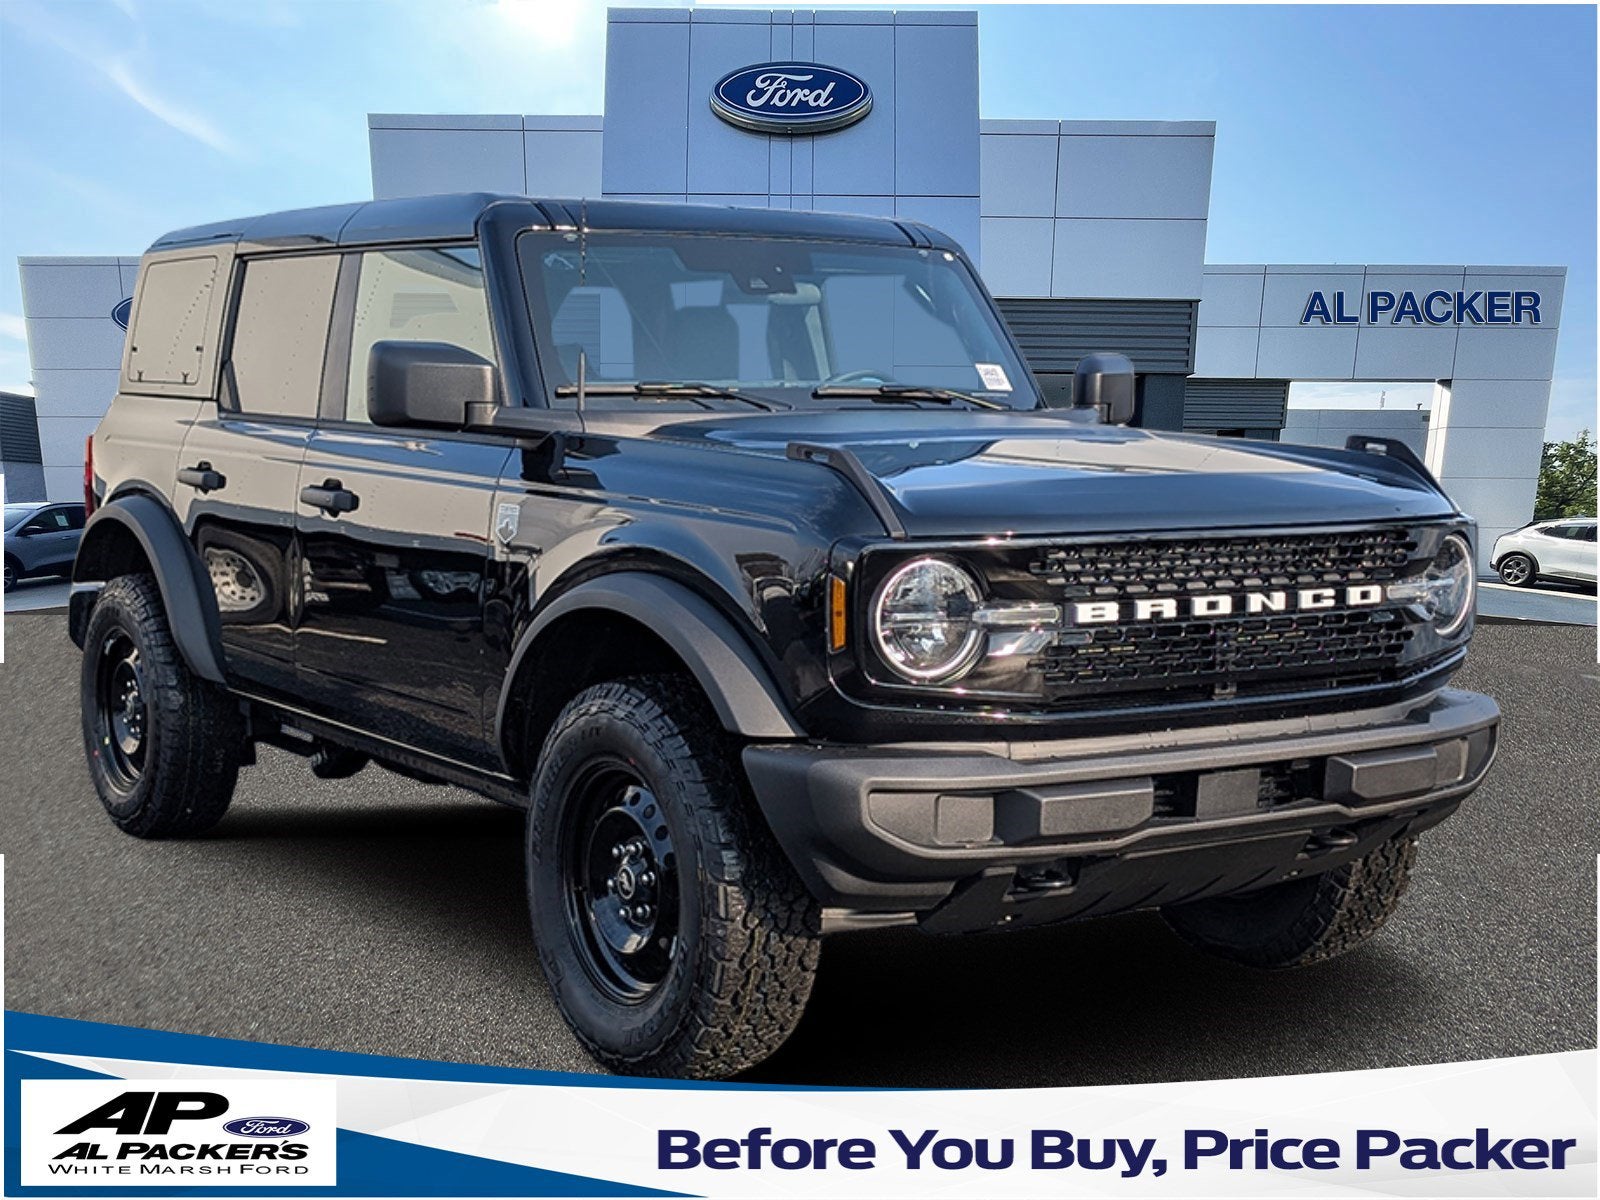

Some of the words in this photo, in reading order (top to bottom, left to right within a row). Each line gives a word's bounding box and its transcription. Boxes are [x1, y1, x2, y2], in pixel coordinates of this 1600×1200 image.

[746, 73, 836, 107] Ford
[1301, 291, 1360, 325] AL
[1368, 290, 1542, 325] PACKER
[1074, 585, 1382, 623] BRONCO
